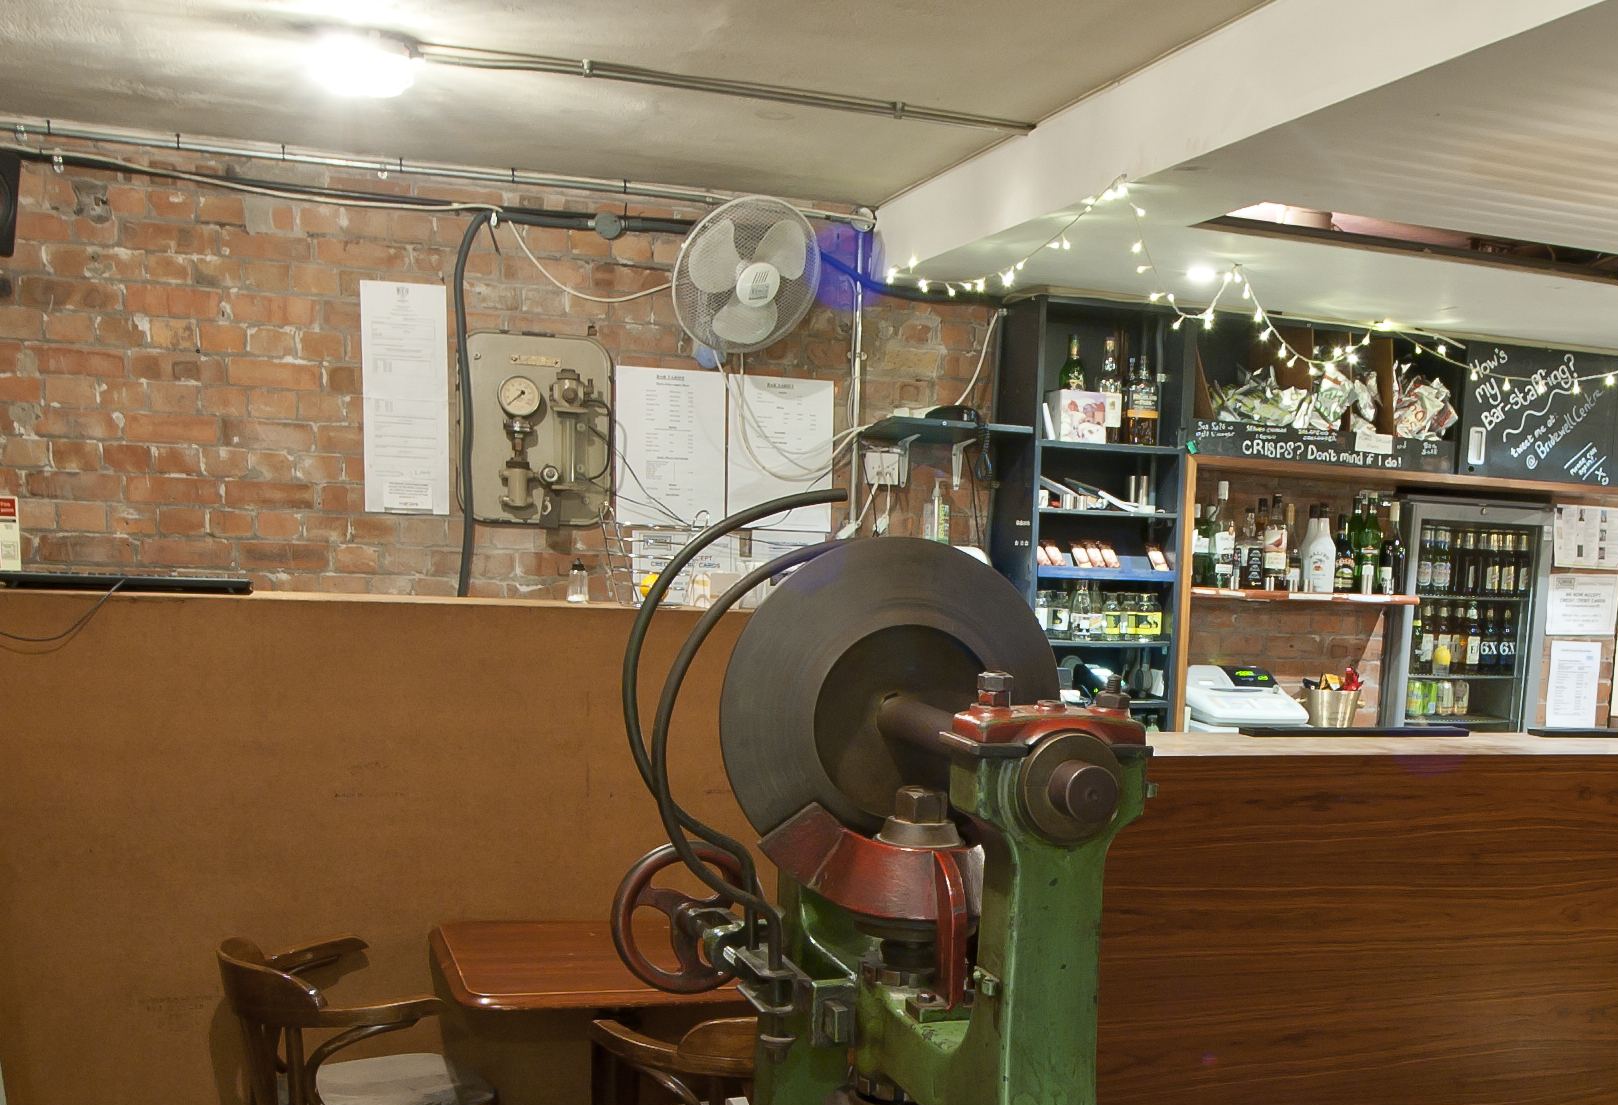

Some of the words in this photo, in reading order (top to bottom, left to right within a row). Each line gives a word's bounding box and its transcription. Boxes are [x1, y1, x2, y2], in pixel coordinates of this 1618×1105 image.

[1470, 348, 1508, 378] How's
[1475, 377, 1501, 405] my
[1242, 440, 1304, 460] CRISPS?
[1308, 444, 1338, 462] Don't
[1340, 451, 1363, 465] mind
[1366, 453, 1375, 466] if
[1378, 455, 1382, 466] I
[1385, 456, 1402, 468] do!
[1510, 434, 1535, 458] tweet
[1534, 425, 1547, 438] me
[1480, 641, 1498, 655] 6X
[1500, 641, 1516, 655] 6X
